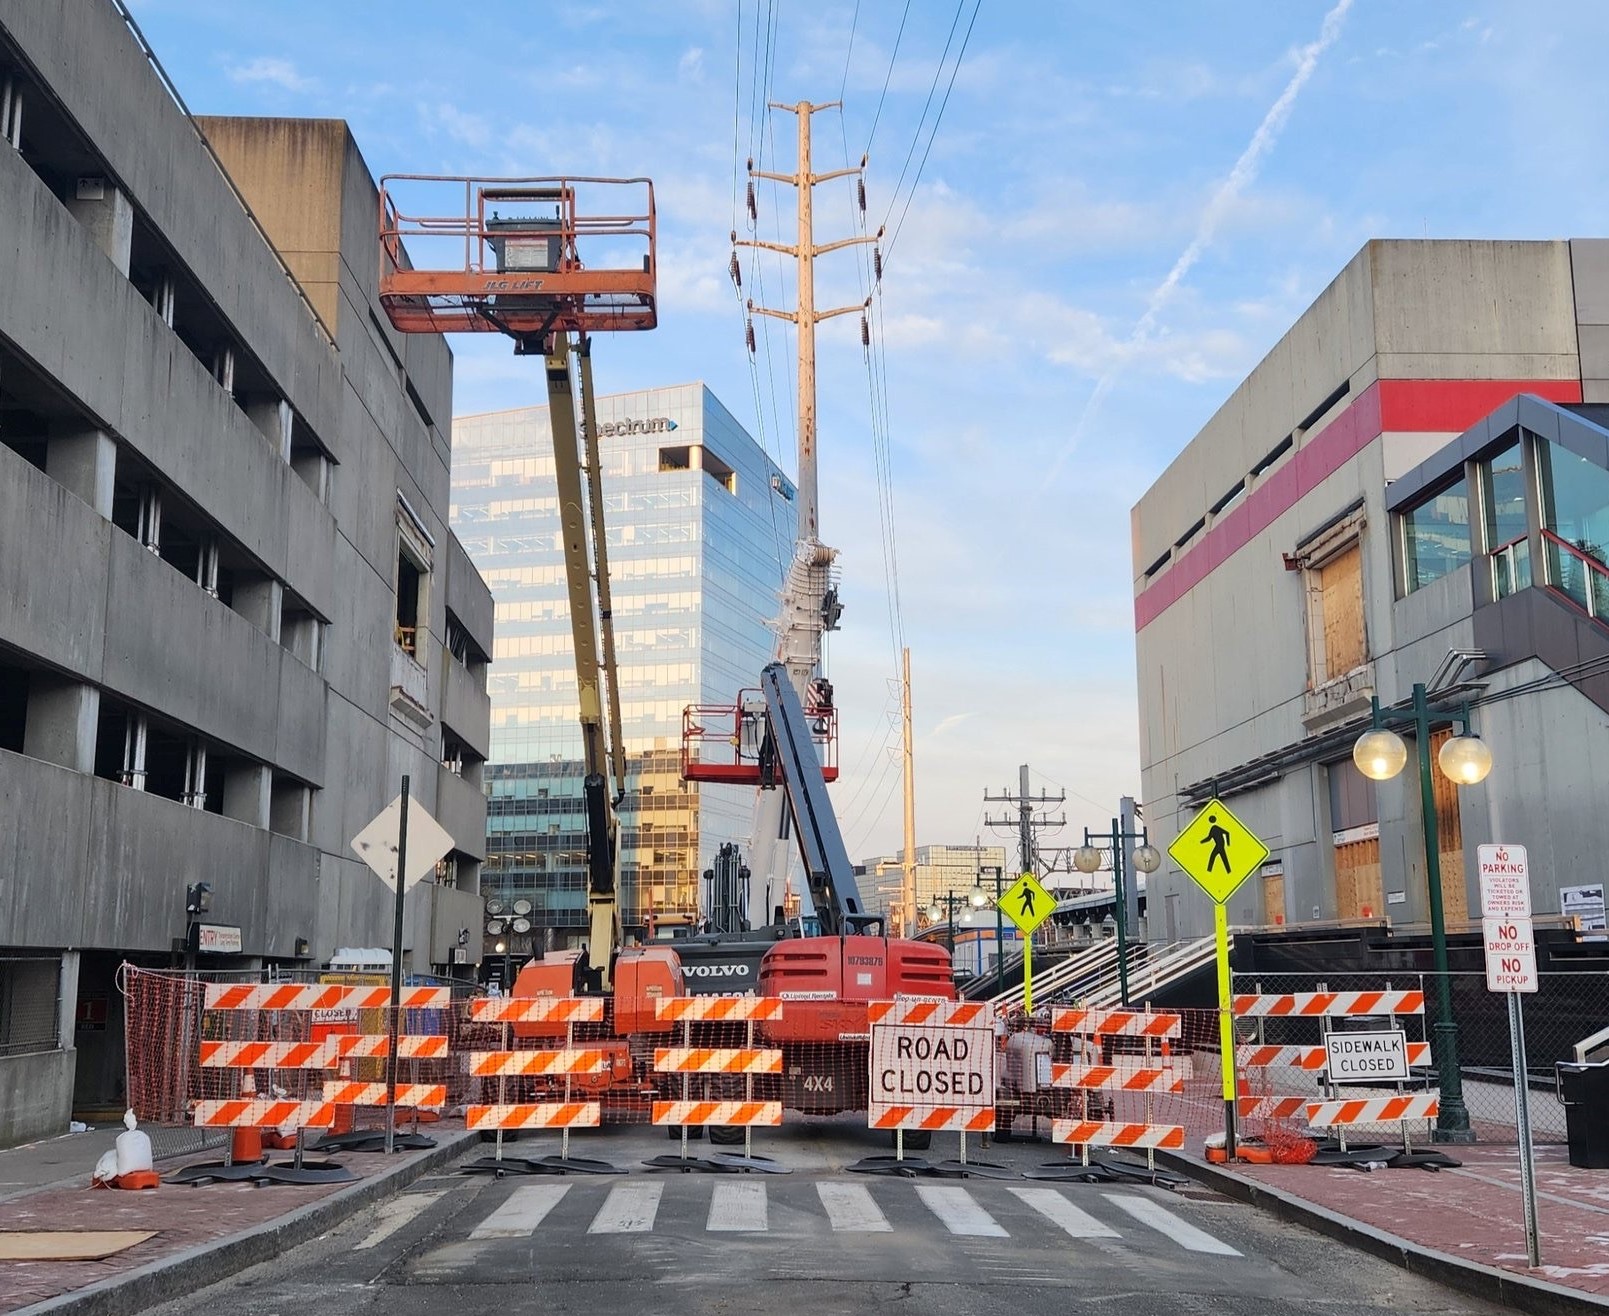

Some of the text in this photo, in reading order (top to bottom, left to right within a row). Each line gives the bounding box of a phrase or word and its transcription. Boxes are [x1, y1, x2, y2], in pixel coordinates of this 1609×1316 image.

[511, 279, 545, 290] LIFT
[1495, 852, 1509, 862] NO
[1482, 864, 1524, 873] PARKING
[1498, 925, 1518, 940] NO
[1489, 942, 1530, 951] DROP OFF
[680, 964, 750, 977] VOLVO
[1501, 958, 1522, 973] NO
[1496, 975, 1529, 984] PICKUP
[897, 1036, 969, 1061] ROAD
[1331, 1040, 1401, 1054] SIDEWALK
[1341, 1058, 1395, 1072] CLOSED
[803, 1075, 833, 1092] 4X4
[881, 1069, 984, 1096] CLOSED
